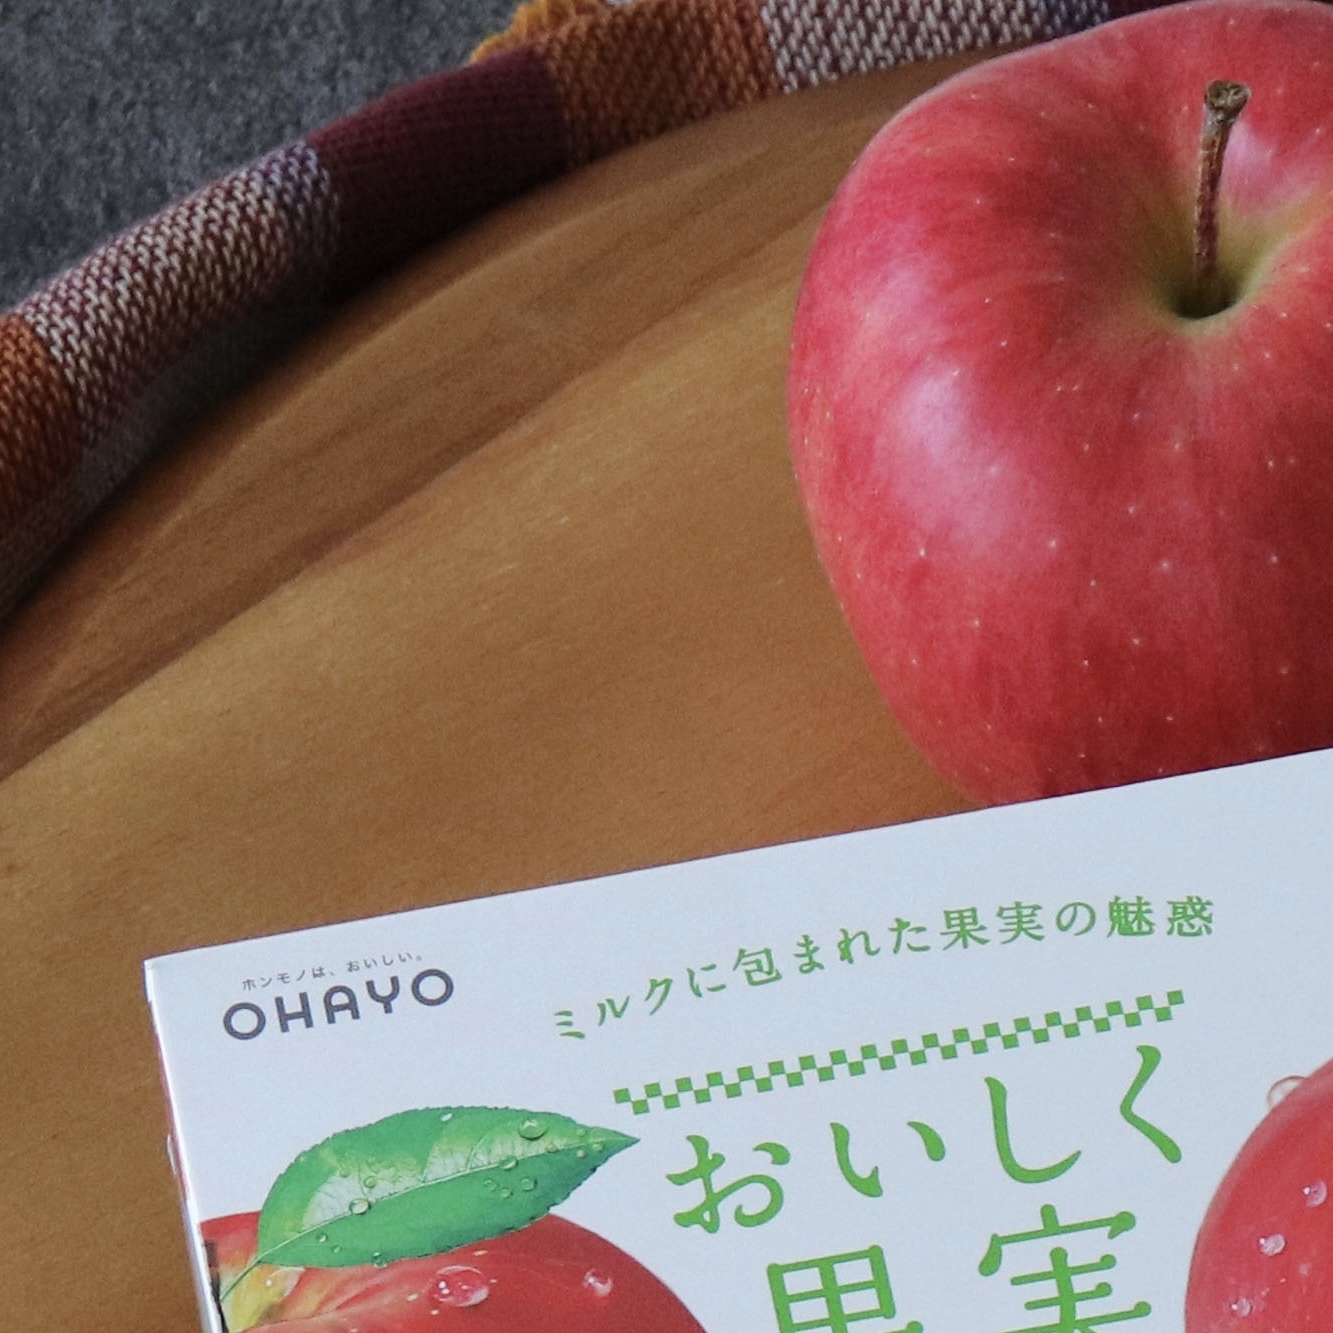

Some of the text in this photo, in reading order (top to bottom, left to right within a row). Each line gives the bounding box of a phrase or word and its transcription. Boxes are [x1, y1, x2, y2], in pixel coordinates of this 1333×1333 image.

[222, 968, 454, 1041] OHAYO
[242, 951, 424, 991] ホンモノは、おいしい。
[553, 895, 1215, 1039] ミルクに包まれた果実の魅惑
[666, 1045, 1182, 1234] おいしく
